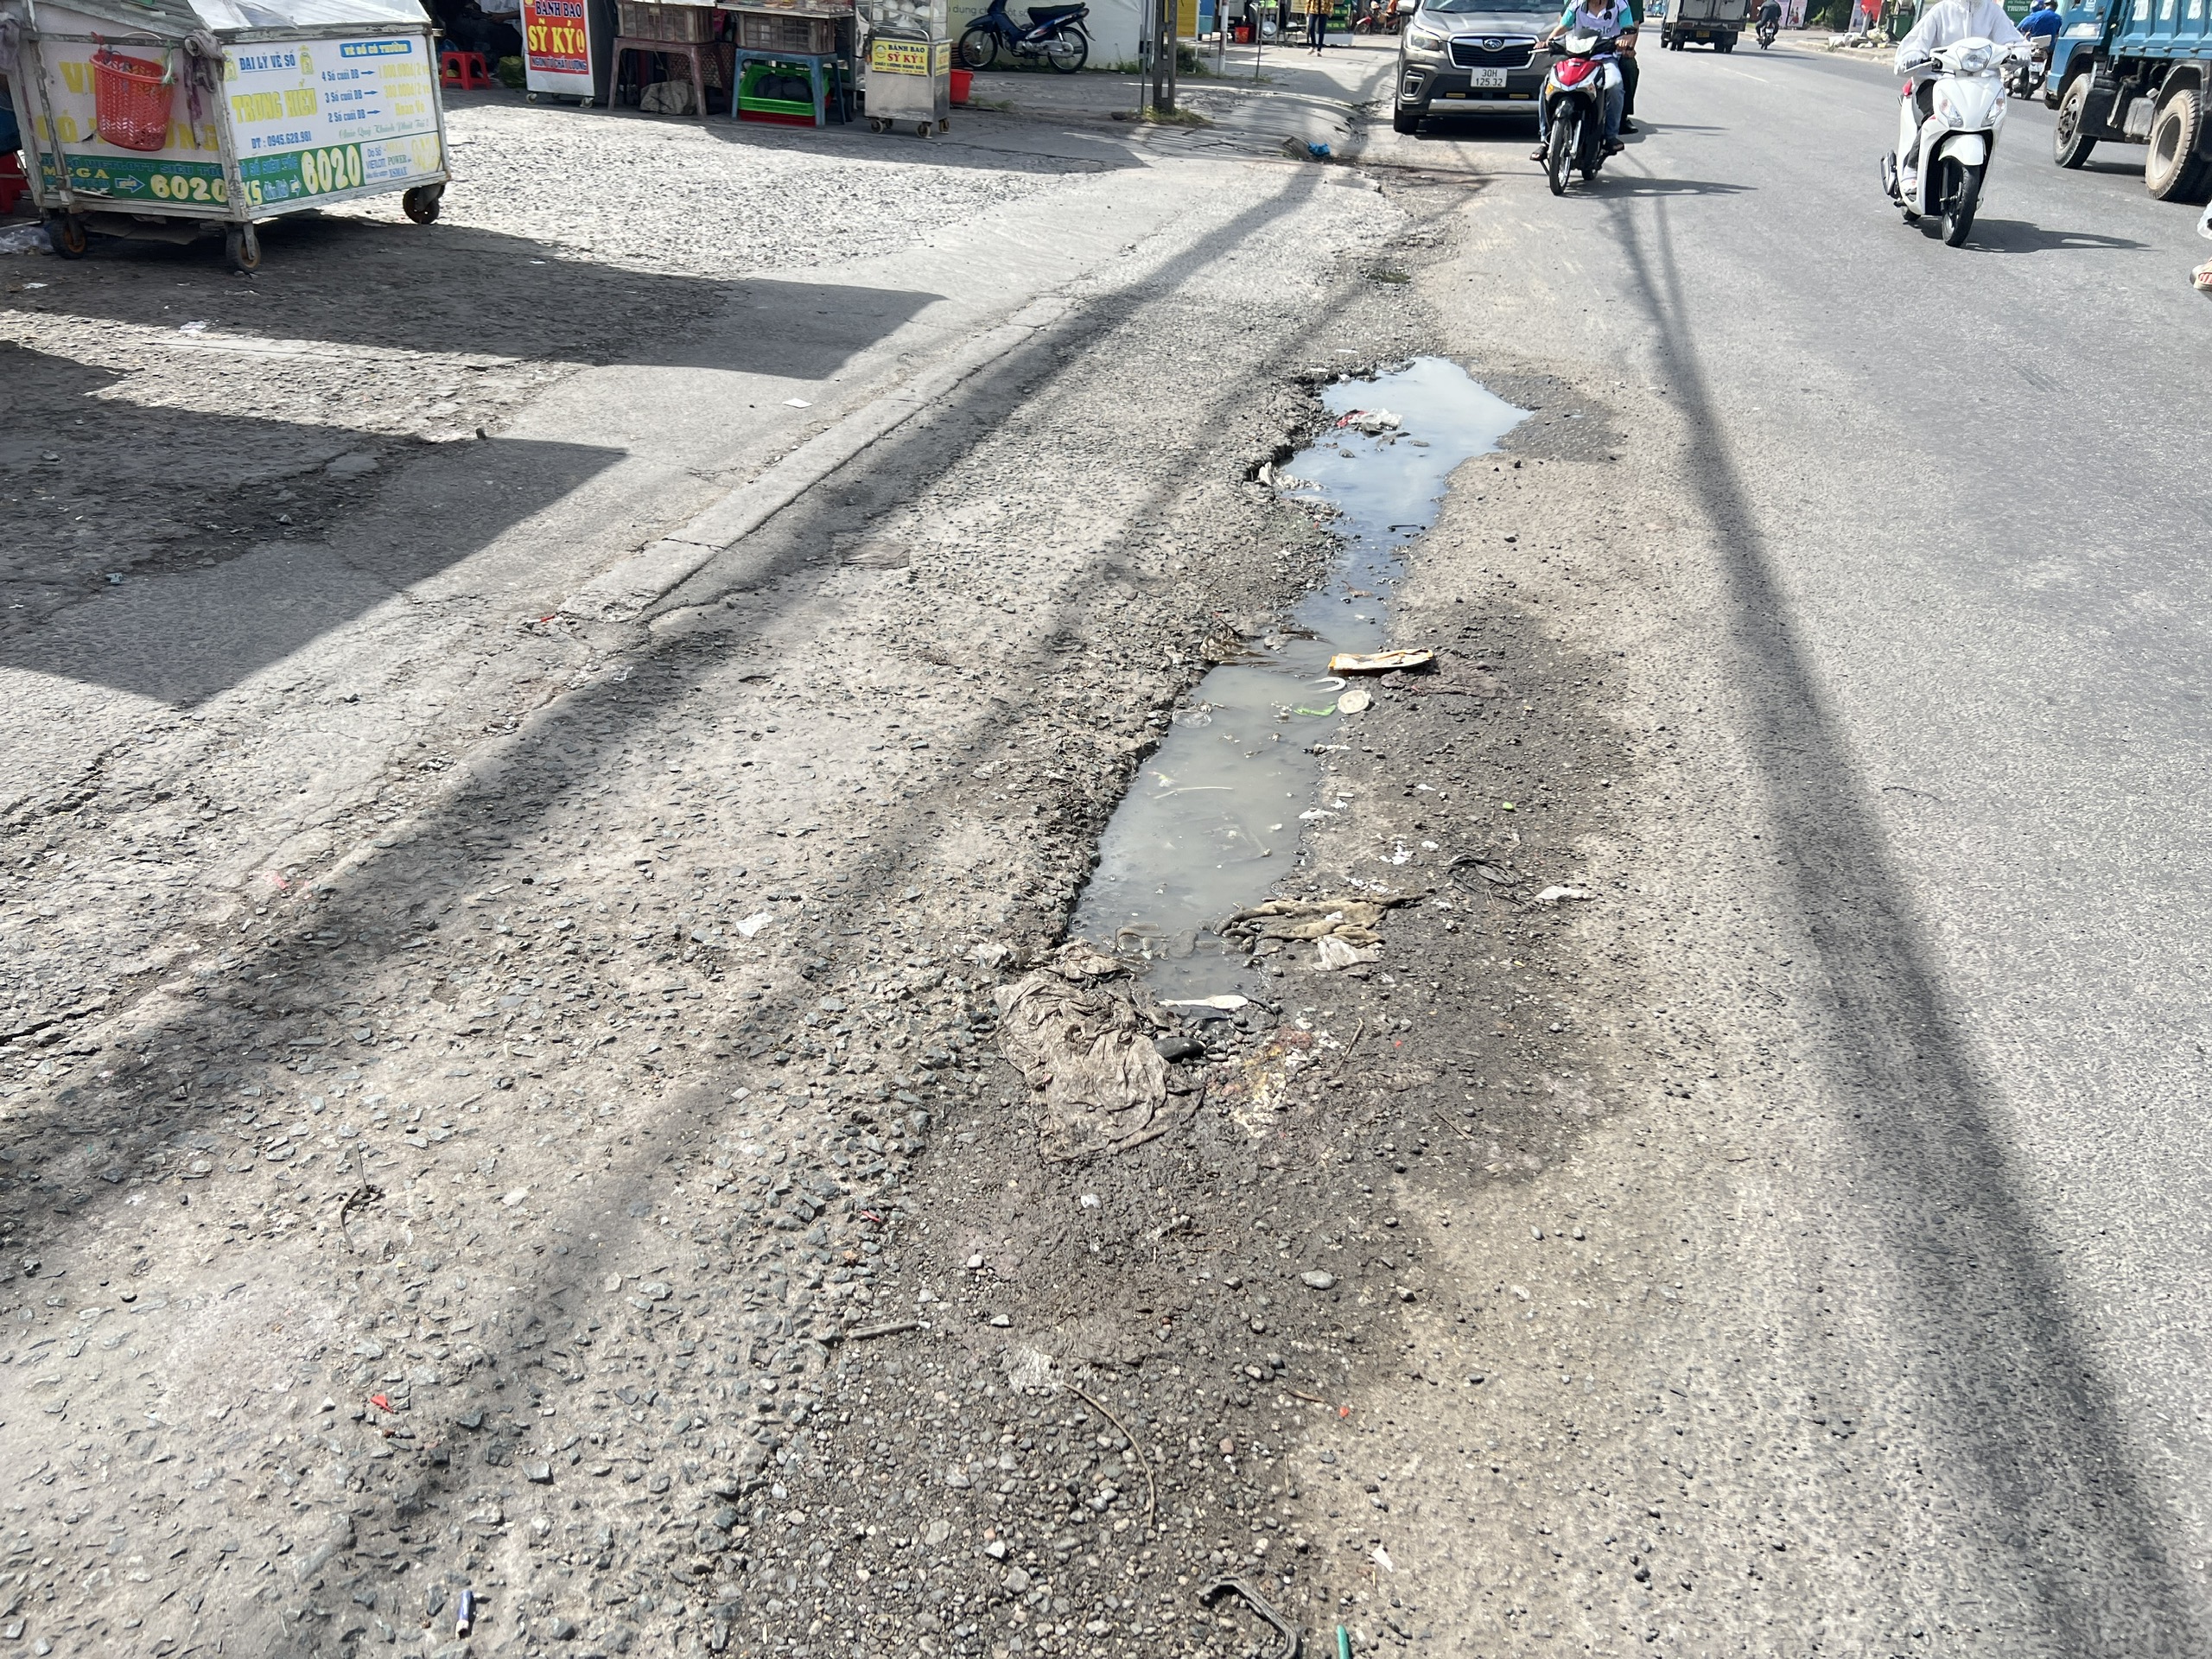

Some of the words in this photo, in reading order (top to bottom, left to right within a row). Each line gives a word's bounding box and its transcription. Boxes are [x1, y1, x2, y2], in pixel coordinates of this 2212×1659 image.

[563, 2, 582, 17] BAO
[528, 18, 548, 52] SỸ
[551, 20, 575, 54] KÝ
[887, 51, 900, 61] SỸ
[903, 53, 918, 63] KÝ
[321, 71, 326, 81] 4
[327, 69, 335, 80] Số
[1476, 78, 1503, 86] 125.32
[325, 92, 330, 103] 3
[331, 90, 339, 102] Số
[328, 112, 334, 123] 2
[334, 110, 342, 122] Số
[266, 130, 312, 147] 0945.628.981
[301, 144, 361, 194] 6020
[150, 175, 227, 202] 6020
